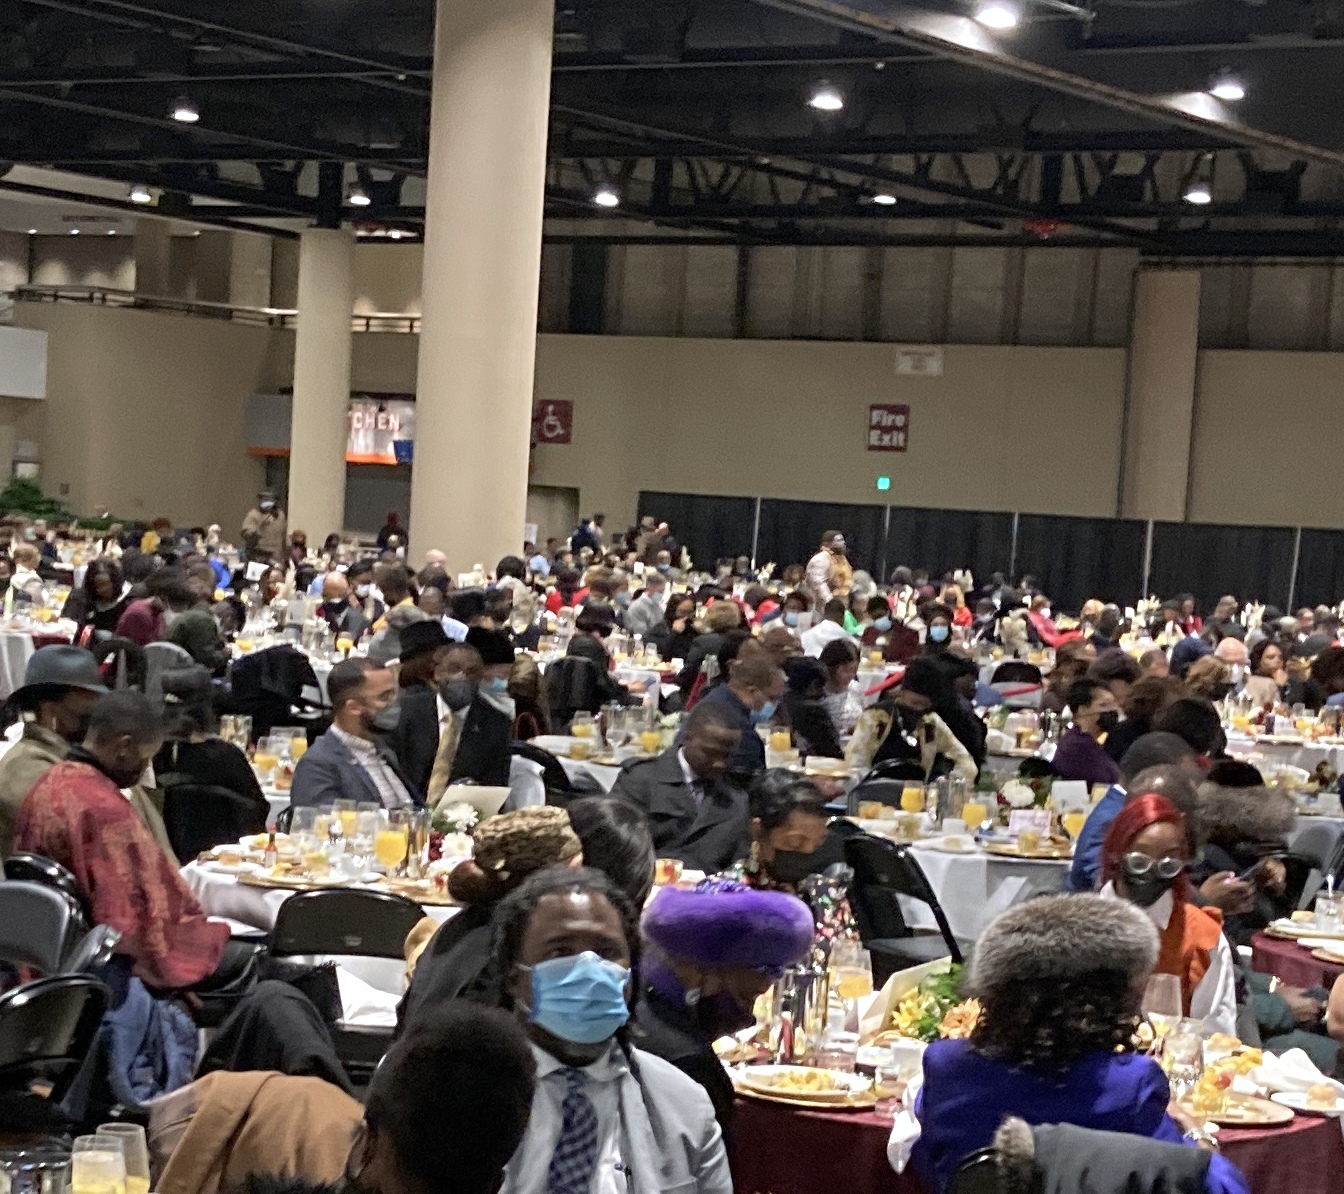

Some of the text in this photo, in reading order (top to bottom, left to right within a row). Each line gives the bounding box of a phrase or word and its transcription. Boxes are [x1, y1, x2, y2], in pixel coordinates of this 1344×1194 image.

[349, 411, 400, 431] CHEN
[871, 409, 905, 427] Fire
[869, 429, 905, 447] Exit
